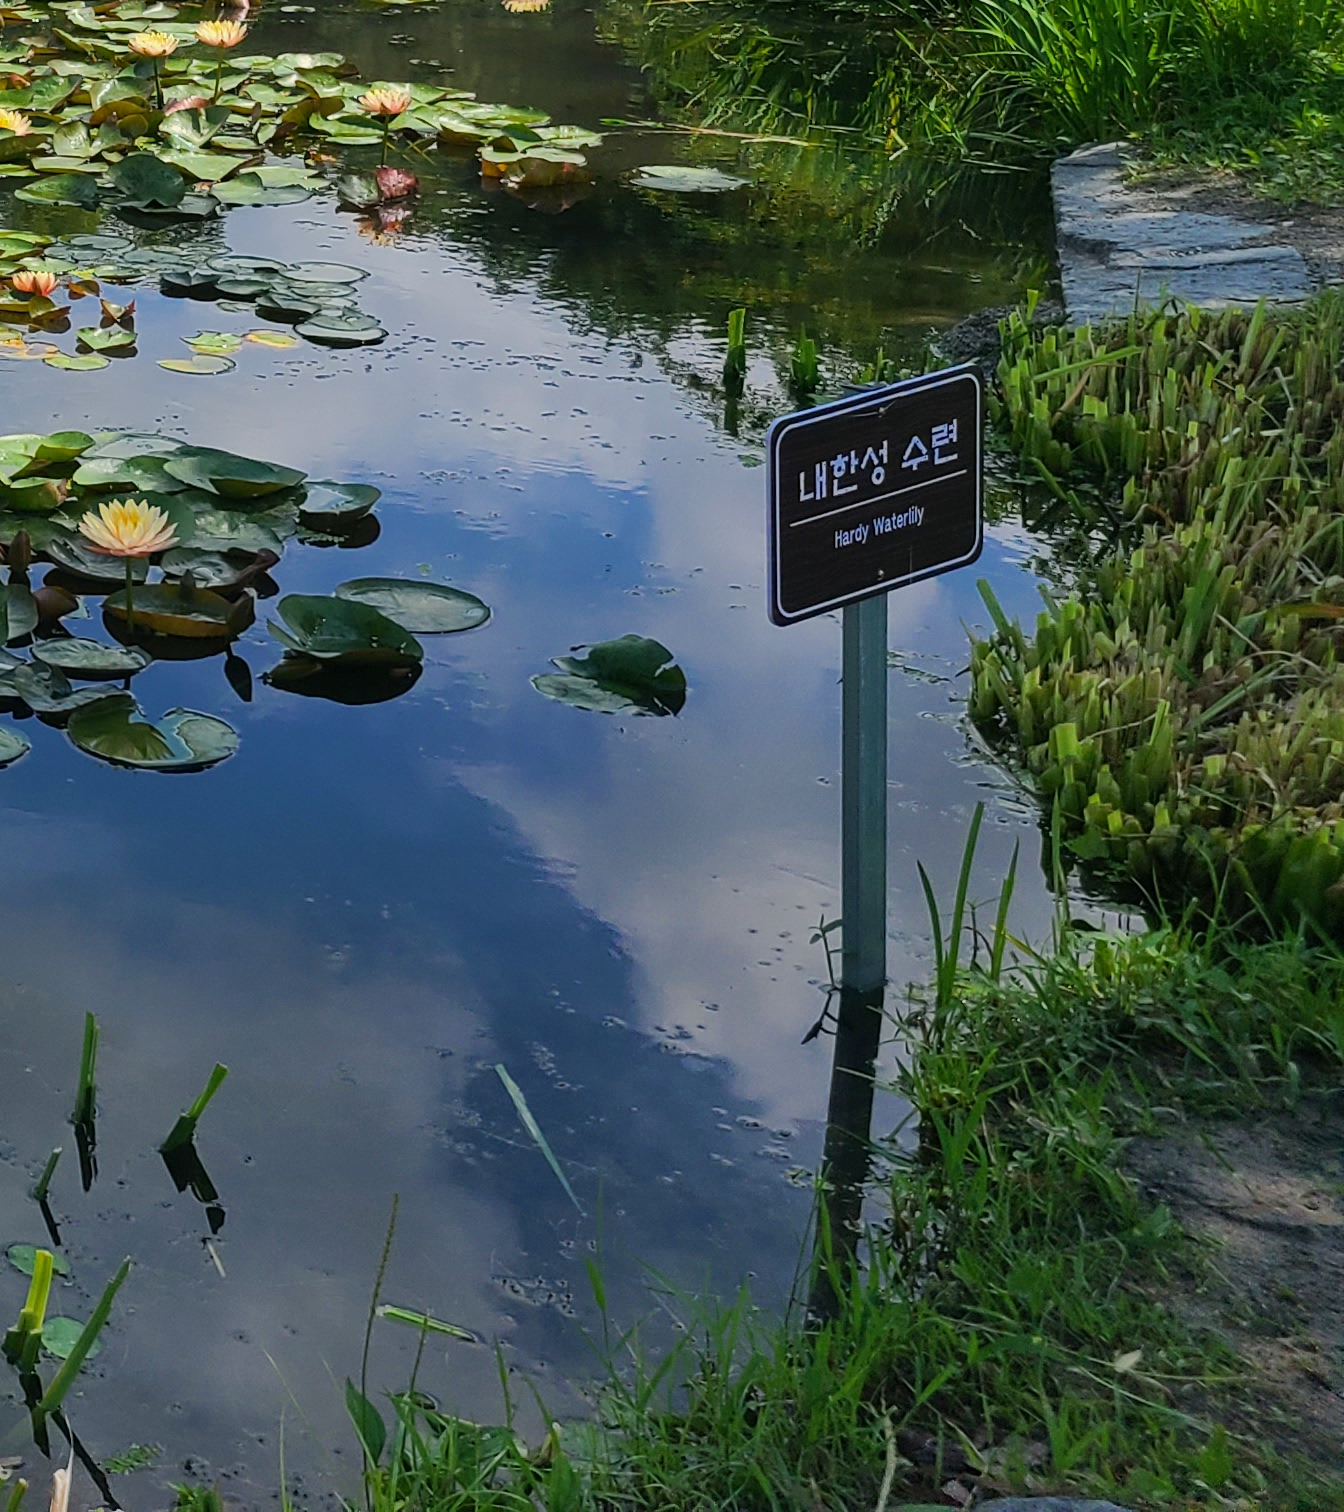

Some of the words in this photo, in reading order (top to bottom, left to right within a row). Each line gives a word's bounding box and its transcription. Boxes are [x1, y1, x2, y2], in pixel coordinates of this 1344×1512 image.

[799, 440, 888, 502] 내한성
[901, 418, 958, 471] 수련
[834, 523, 869, 548] Hardy
[873, 505, 924, 536] Waterlily
